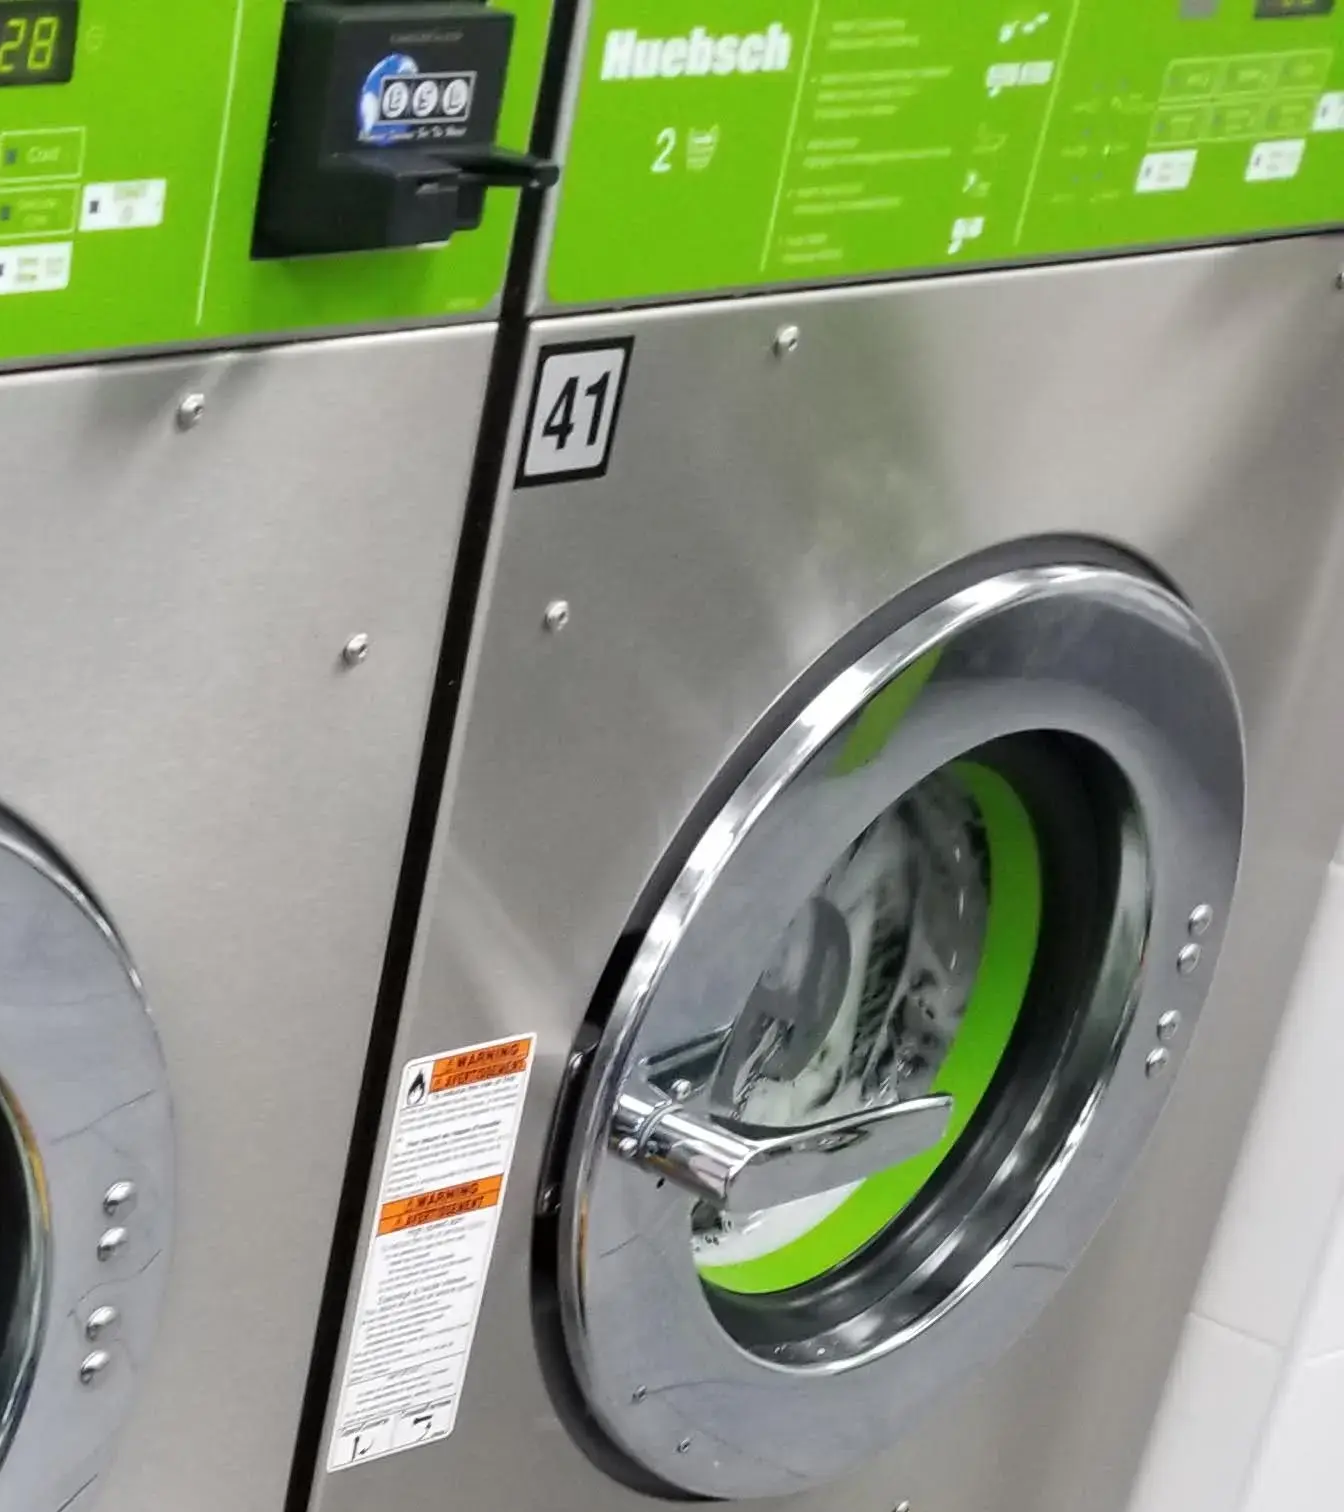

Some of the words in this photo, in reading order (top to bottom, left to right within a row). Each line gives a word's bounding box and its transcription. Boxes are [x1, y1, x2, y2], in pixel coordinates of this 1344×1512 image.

[601, 22, 792, 80] Huebsch
[651, 128, 676, 173] 2
[542, 370, 611, 450] 41
